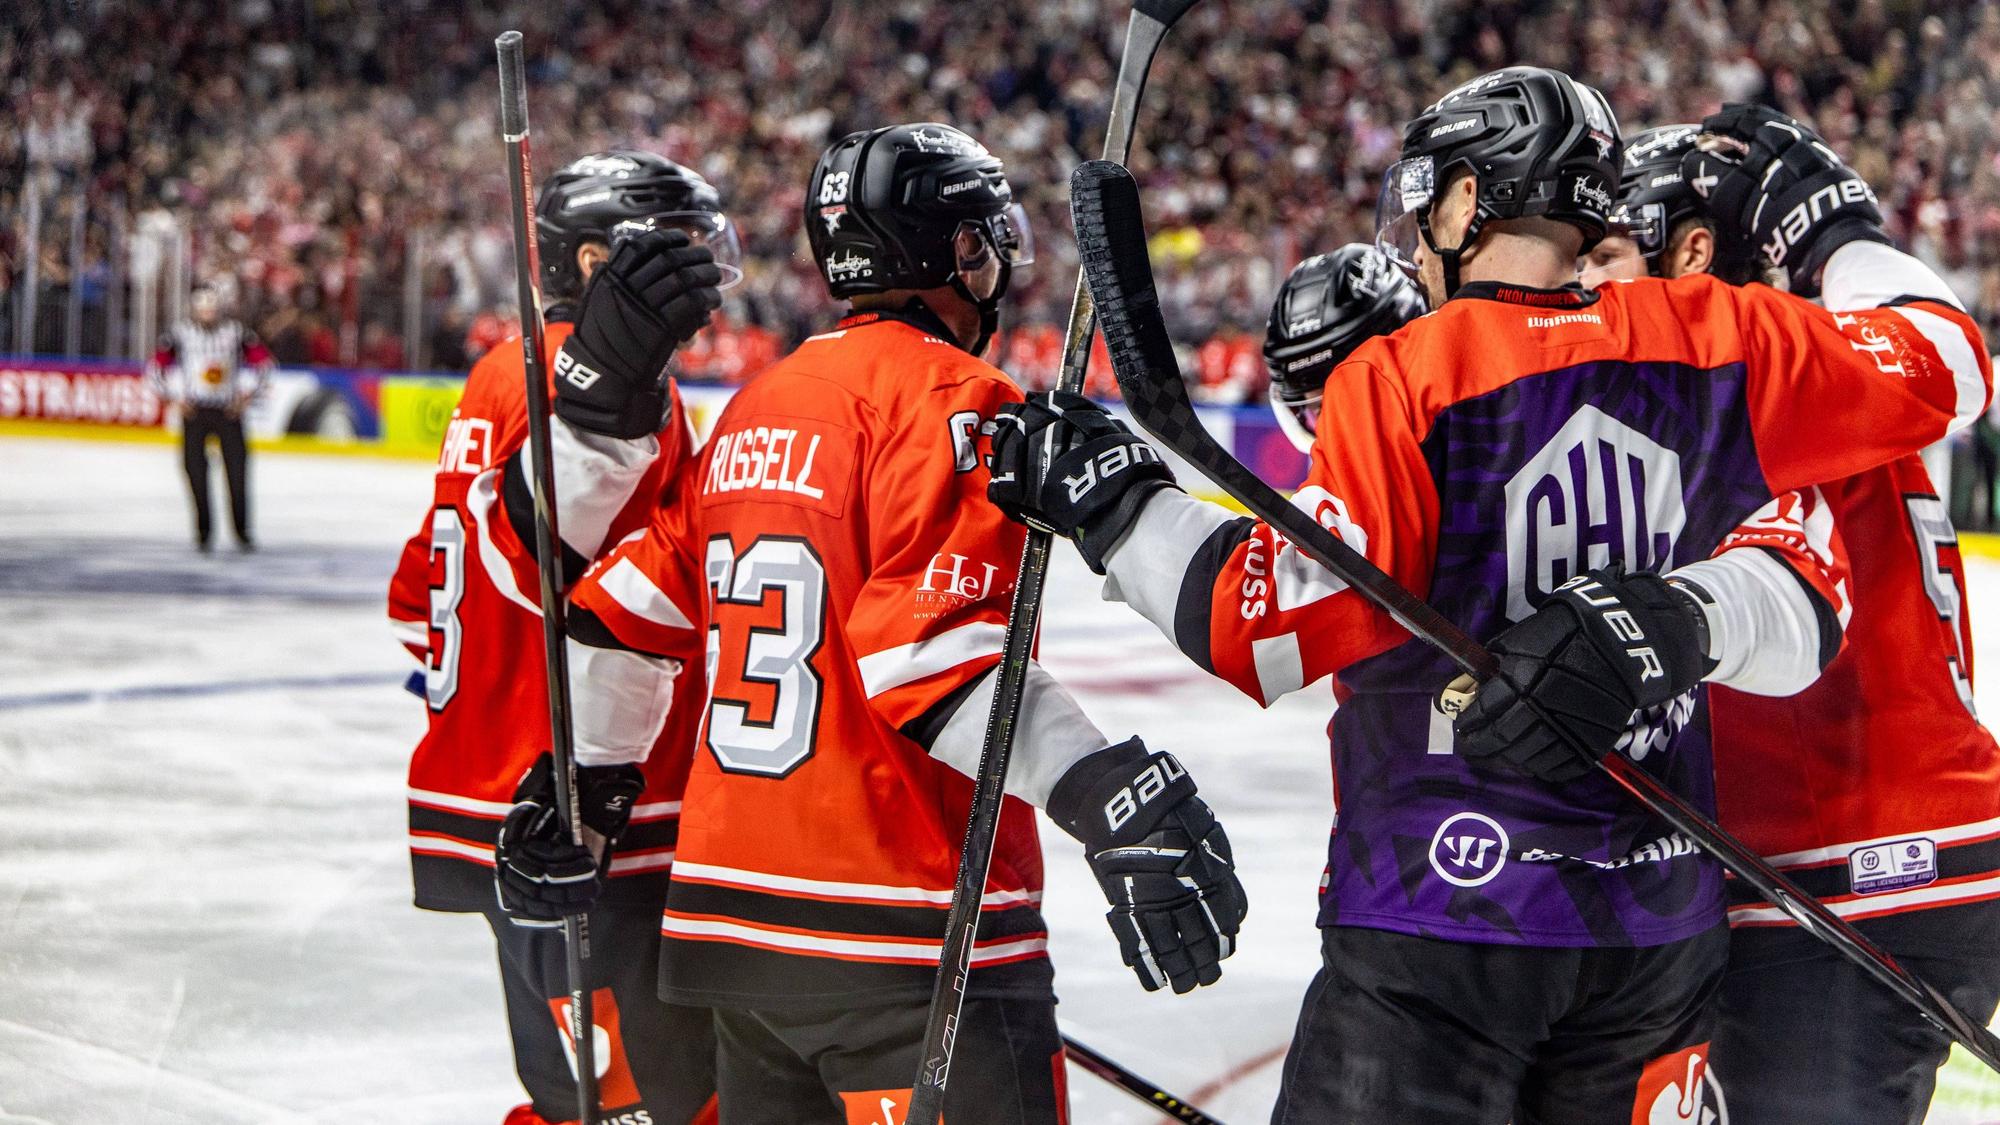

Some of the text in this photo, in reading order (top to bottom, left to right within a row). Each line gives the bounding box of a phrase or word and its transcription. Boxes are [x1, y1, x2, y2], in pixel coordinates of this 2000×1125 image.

[1430, 118, 1477, 138] BAUER
[820, 171, 850, 204] 63
[943, 178, 983, 195] BAUER
[828, 267, 873, 283] LAND
[1527, 313, 1602, 328] WARRIOR
[554, 346, 601, 391] BA
[1287, 349, 1333, 372] BAUER
[0, 370, 158, 427] STRAUSS
[702, 427, 824, 501] RUSSELL
[1061, 443, 1160, 504] UER
[1525, 438, 1672, 607] CHL
[916, 552, 999, 602] HeJ
[1103, 754, 1187, 833] BAU
